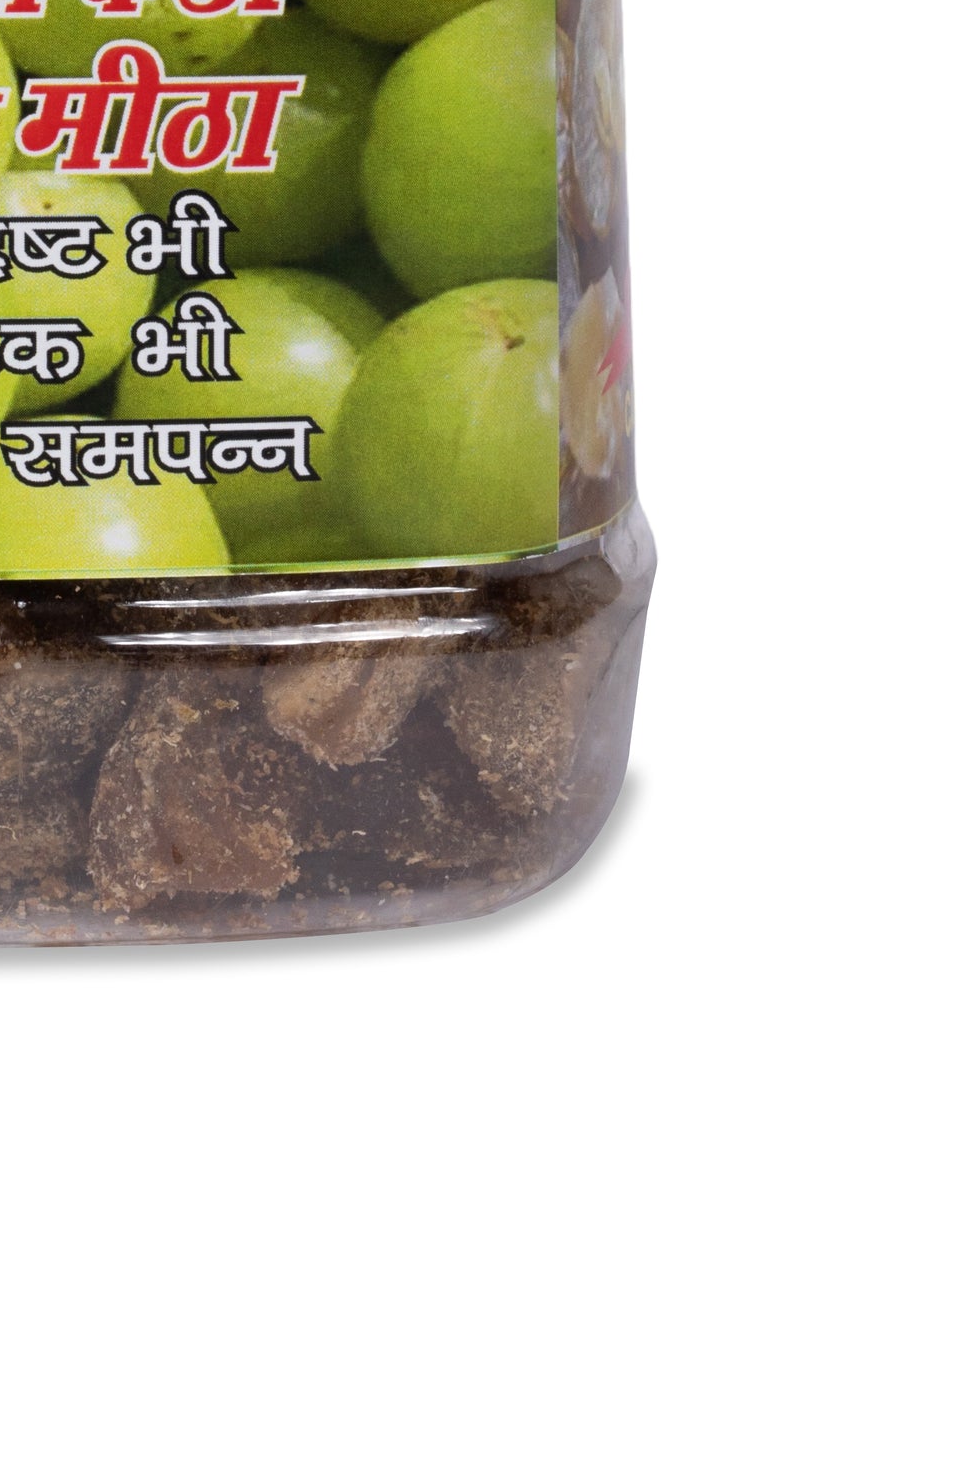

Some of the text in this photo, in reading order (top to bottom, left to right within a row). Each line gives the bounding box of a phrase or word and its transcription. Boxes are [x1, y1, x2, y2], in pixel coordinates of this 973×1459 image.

[16, 39, 306, 173] मीठा
[126, 189, 238, 280] भी
[132, 292, 243, 382] भी
[0, 416, 322, 487] समपन्न
